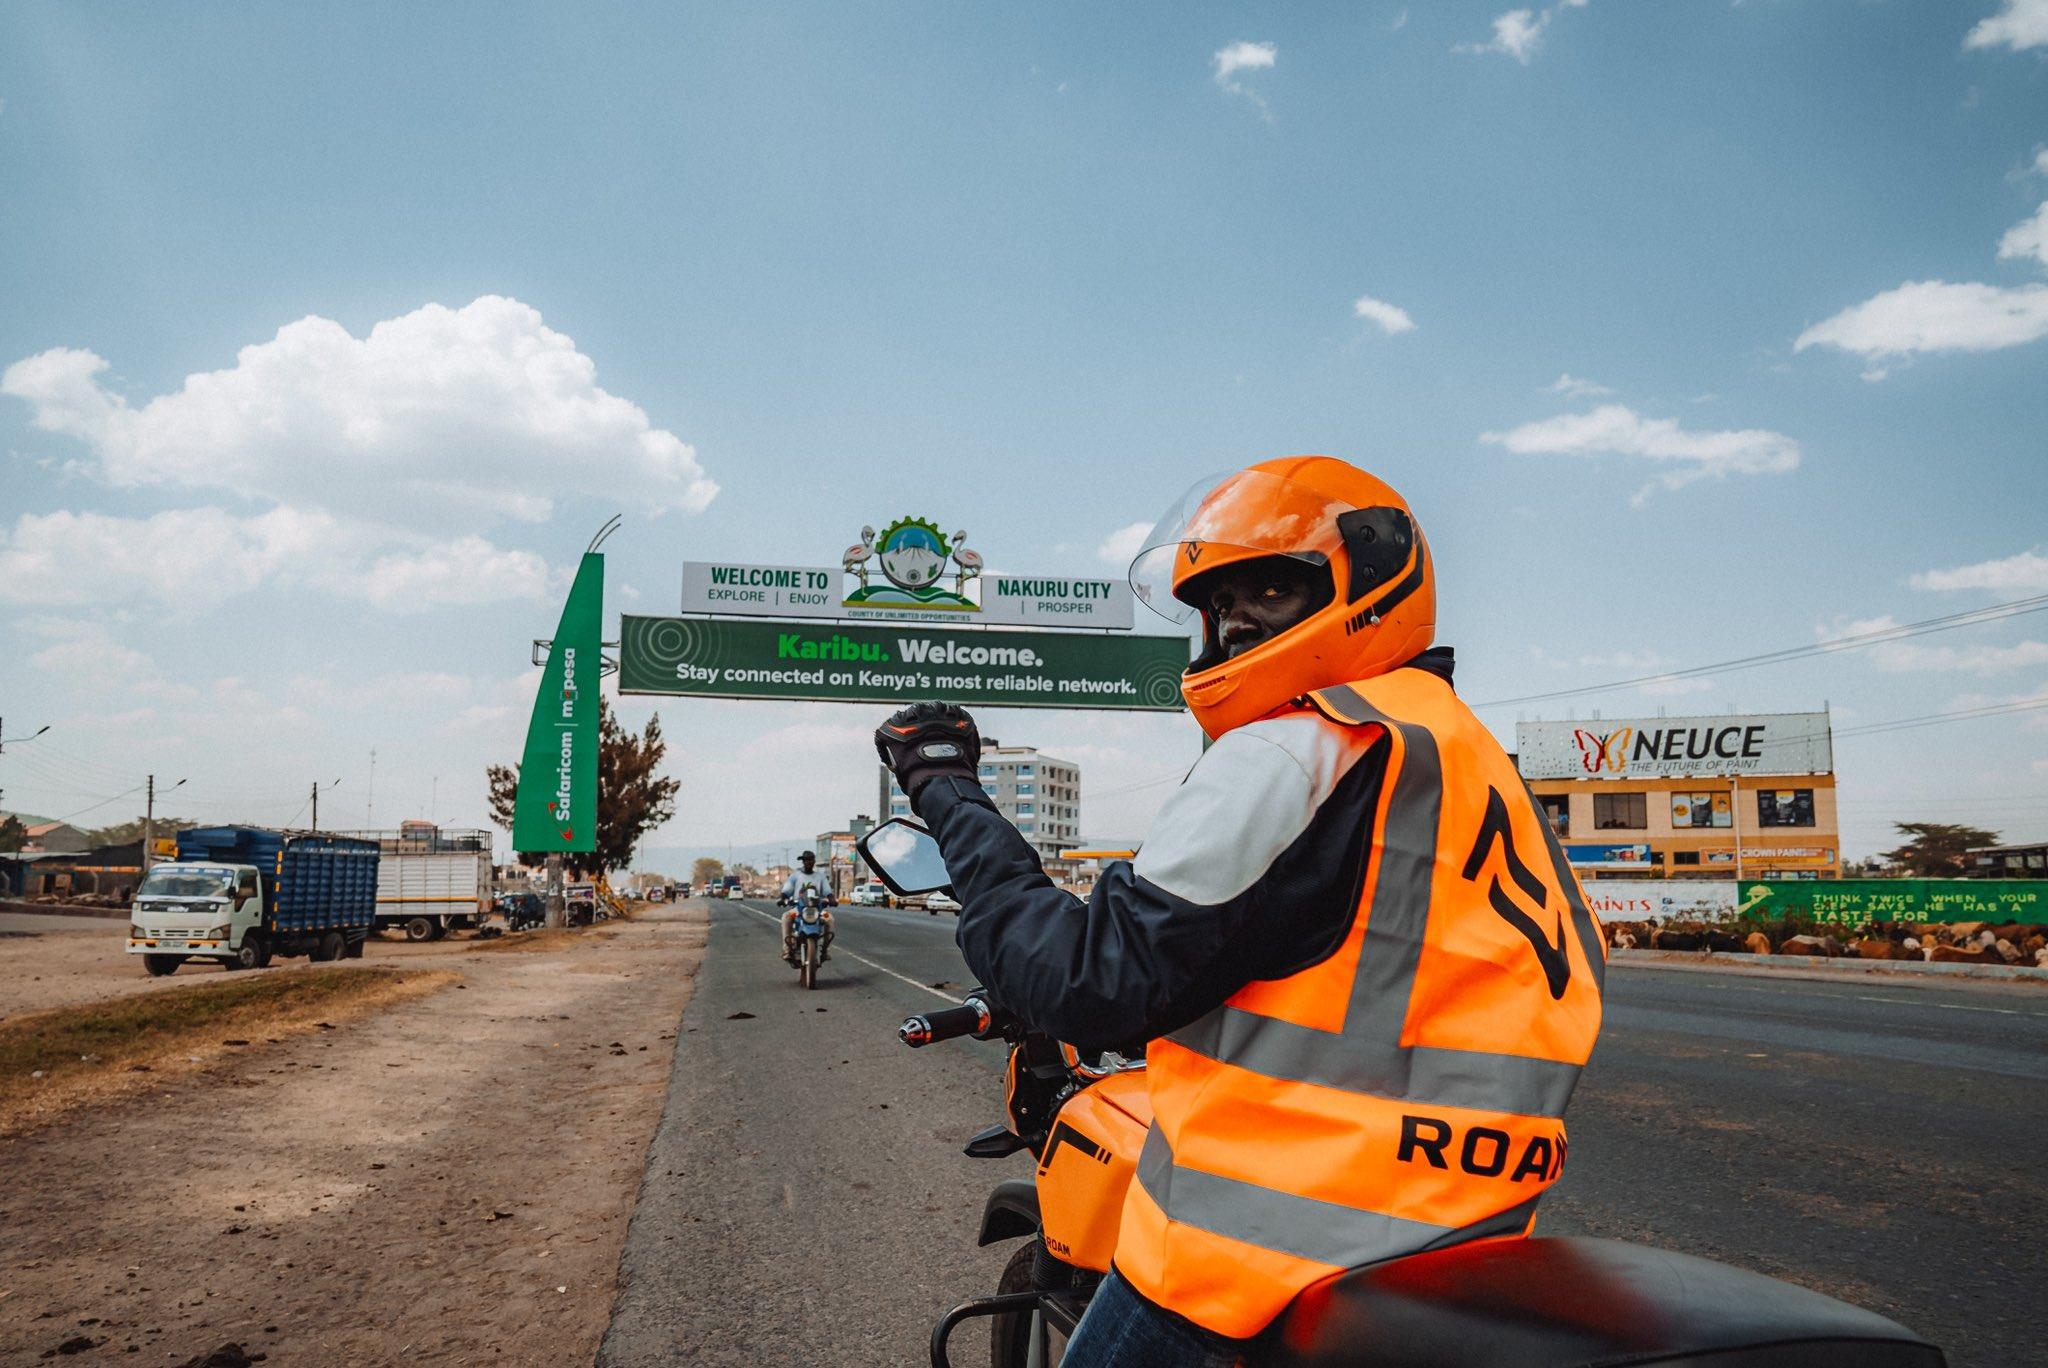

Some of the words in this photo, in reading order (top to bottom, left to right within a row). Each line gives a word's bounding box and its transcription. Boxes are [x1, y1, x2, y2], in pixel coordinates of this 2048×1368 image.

[711, 567, 801, 588] WELCOME
[806, 572, 828, 589] TO
[708, 589, 765, 602] EXPLORE
[790, 592, 828, 605] ENJOY
[998, 580, 1068, 597] NAKURU
[1074, 582, 1111, 599] CITY
[1038, 601, 1092, 613] PROSPER
[848, 610, 874, 618] COUNTY
[885, 611, 919, 619] UNLIMITED
[921, 613, 971, 621] OPPORTUNITIES
[778, 634, 889, 662] Karibu.
[898, 639, 1043, 667] Welcome.
[676, 663, 719, 684] Stay
[724, 668, 824, 685] connected
[829, 672, 853, 685] on
[859, 670, 930, 691] Kenya's
[936, 674, 981, 690] most
[986, 674, 1053, 692] reliable
[1059, 678, 1137, 694] network.
[1632, 725, 1766, 761] NEUCE
[1630, 763, 1651, 772] THE
[1656, 760, 1702, 772] FUTURE
[1706, 760, 1722, 769] OF
[1726, 759, 1760, 769] PAINT
[556, 732, 573, 821] Safaricom
[1740, 848, 1777, 857] CROWN
[1812, 894, 1862, 903] THINK
[1870, 894, 1915, 903] TWICE
[1931, 894, 1976, 903] WHEN
[1999, 893, 2037, 902] YOUR
[1867, 902, 1906, 911] SAYS
[1925, 902, 1945, 911] HE
[1963, 902, 1998, 912] HAS
[2011, 902, 2022, 912] A
[1814, 911, 1873, 921] TASTE
[1893, 911, 1929, 921] FOR
[1046, 1236, 1071, 1257] ROAM
